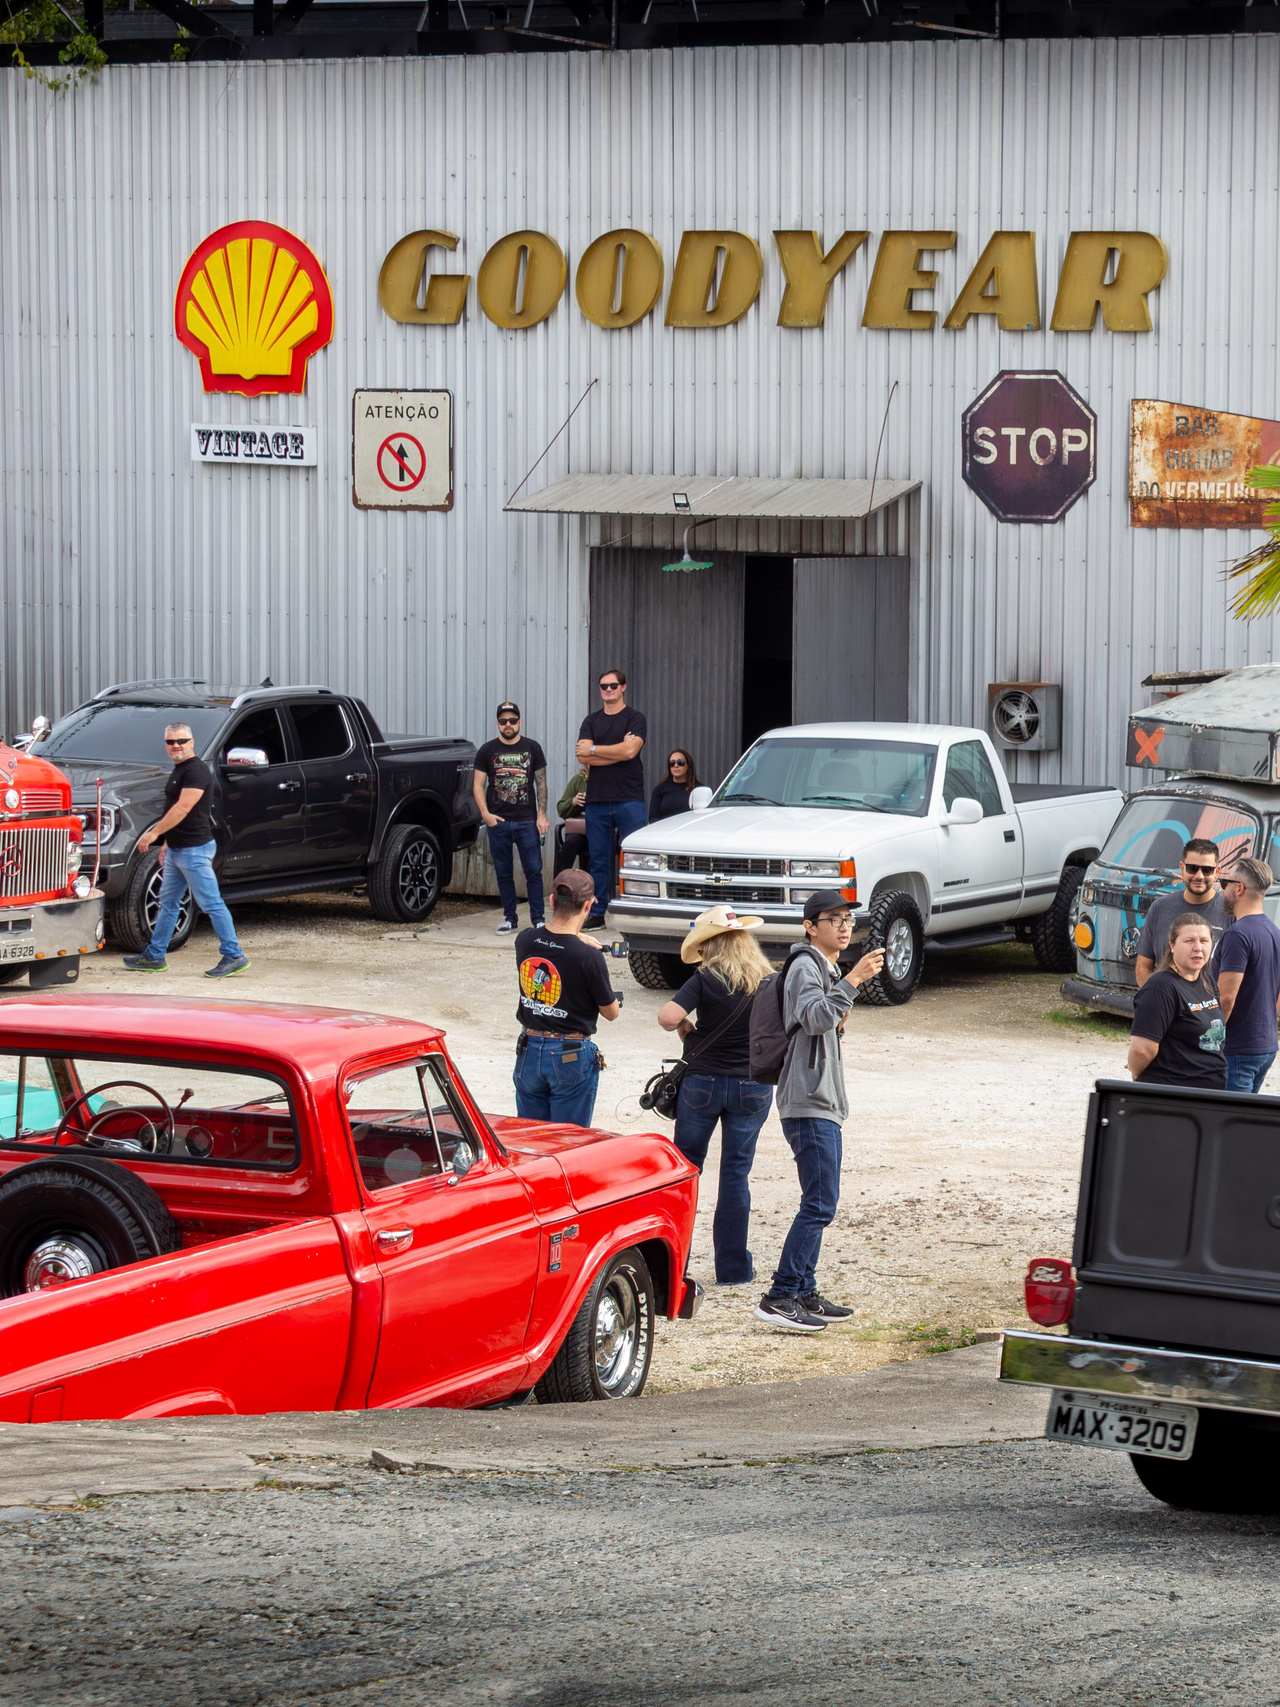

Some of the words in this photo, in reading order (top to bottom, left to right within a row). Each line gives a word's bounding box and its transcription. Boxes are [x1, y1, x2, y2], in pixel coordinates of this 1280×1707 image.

[378, 229, 1168, 332] GOODYEAR
[365, 402, 439, 422] ATENÇÃO
[1175, 414, 1219, 438] BAR
[195, 428, 305, 460] VINTAGE
[972, 425, 1089, 467] STOP
[1165, 448, 1236, 470] BILHAR
[1031, 1265, 1063, 1283] Ford
[631, 1291, 649, 1380] DYNAMIC
